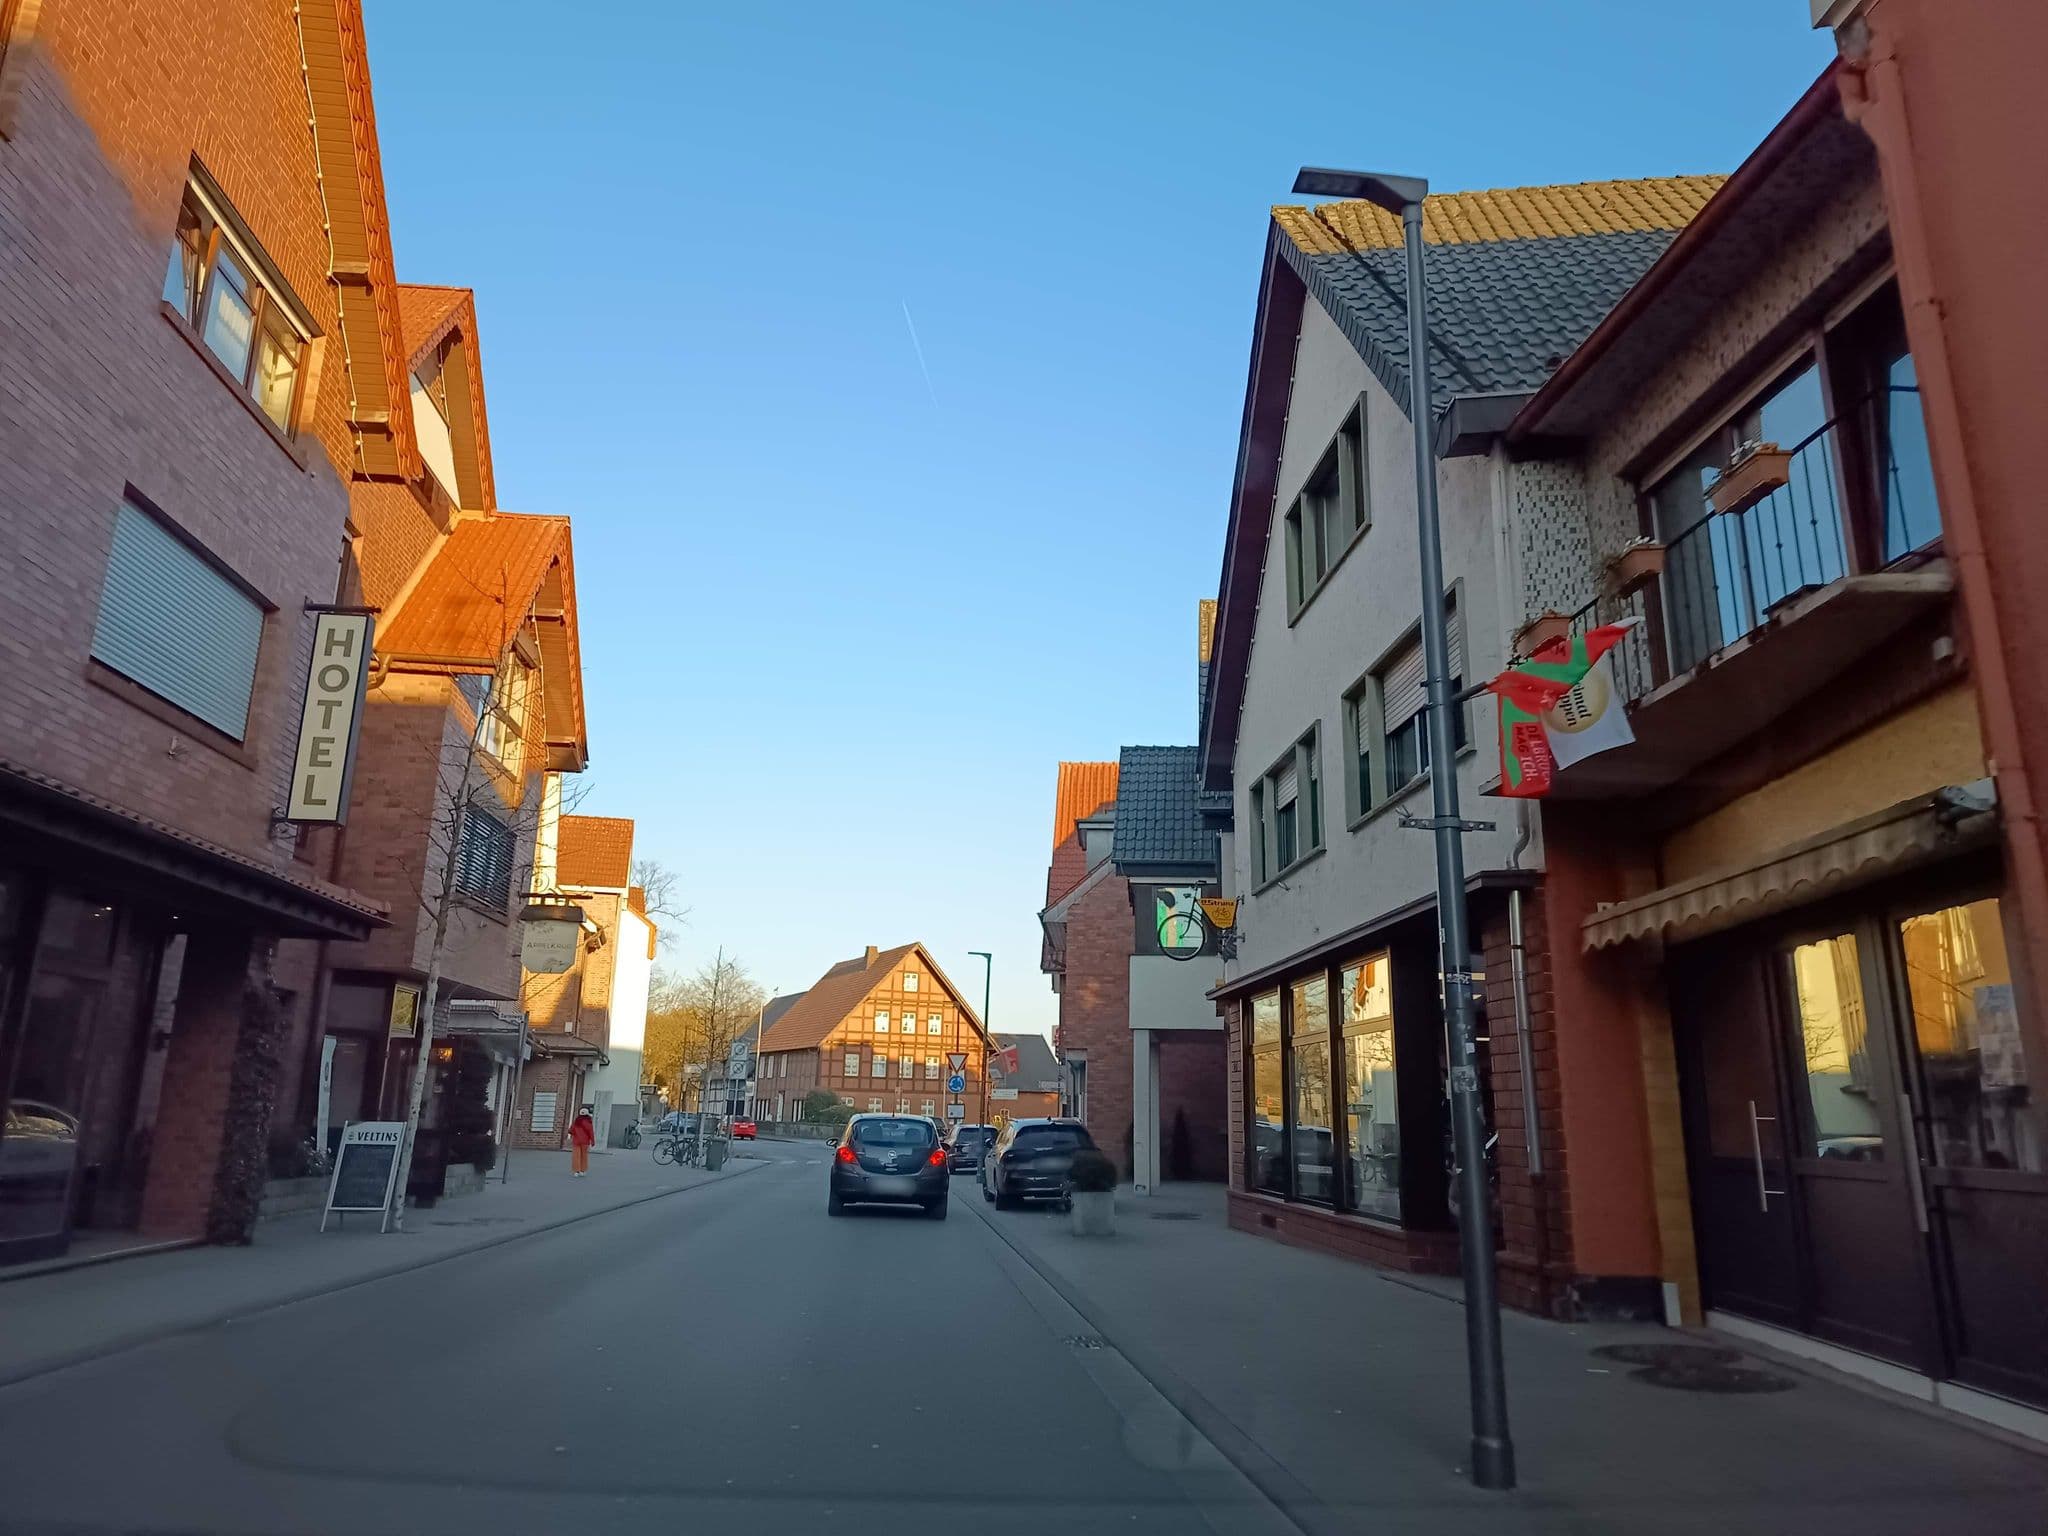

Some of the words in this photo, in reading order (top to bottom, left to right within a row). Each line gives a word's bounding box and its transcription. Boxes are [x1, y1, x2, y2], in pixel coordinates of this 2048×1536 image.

[303, 628, 354, 806] HOTEL
[1515, 726, 1530, 753] MAG
[357, 1131, 399, 1142] VELTINS
